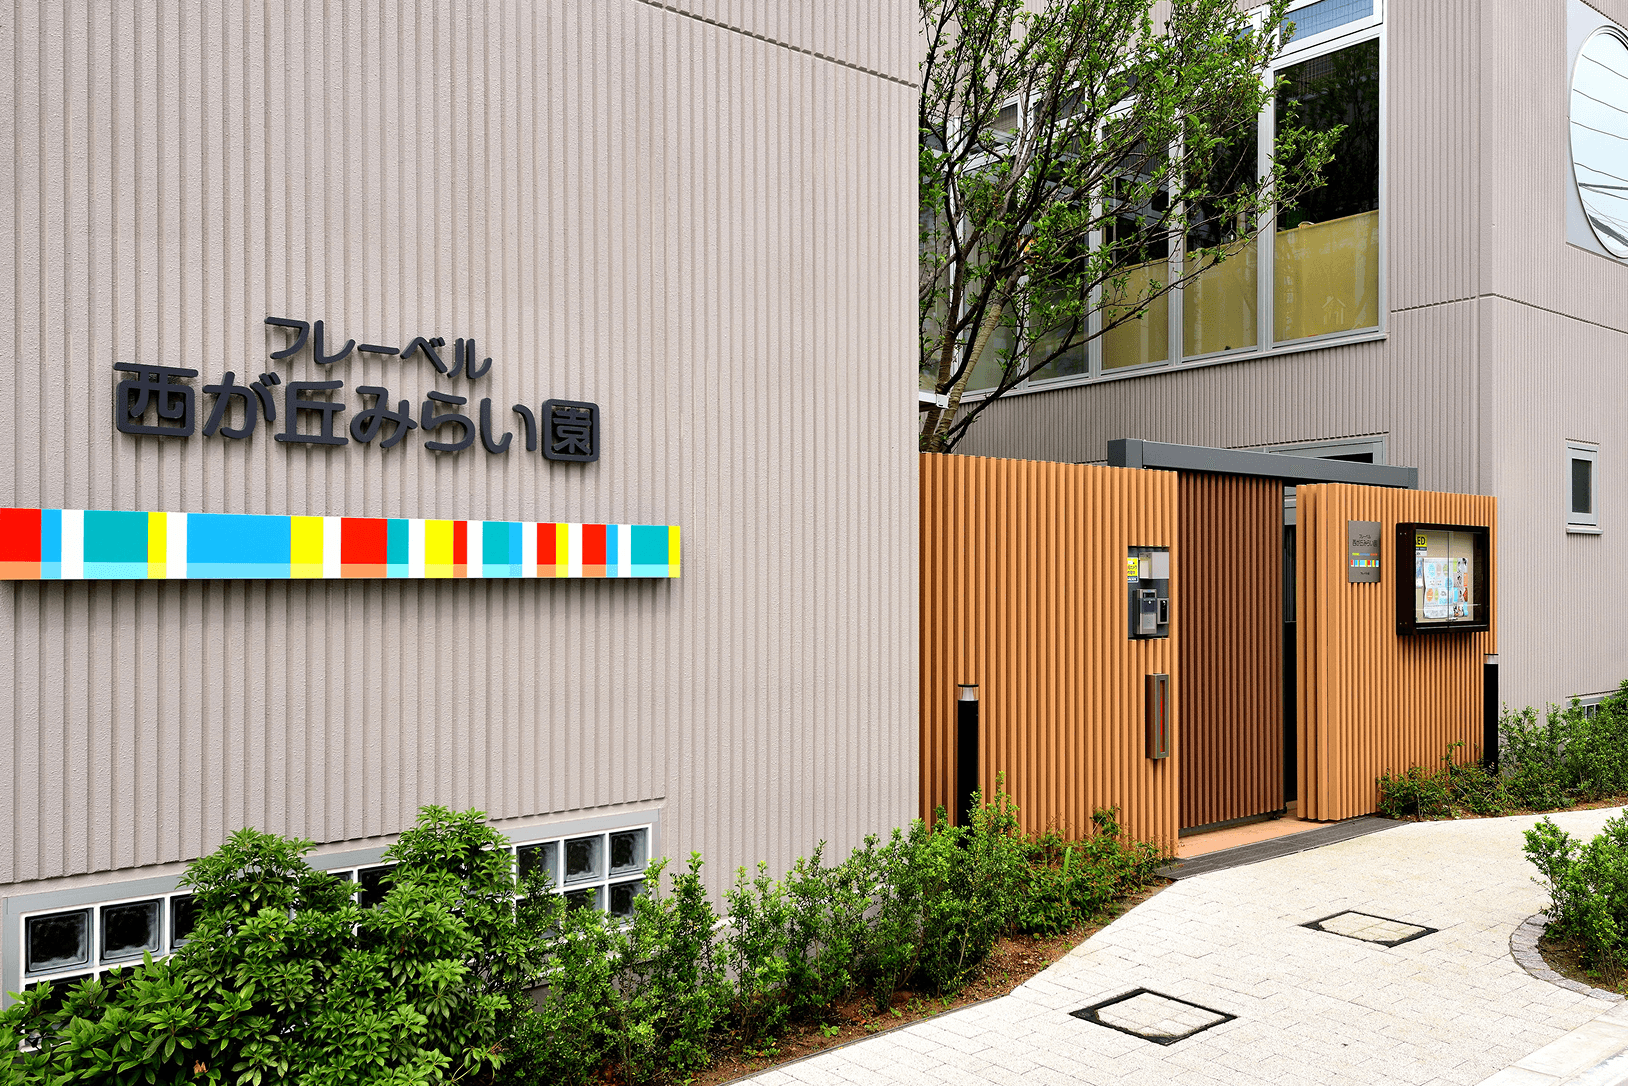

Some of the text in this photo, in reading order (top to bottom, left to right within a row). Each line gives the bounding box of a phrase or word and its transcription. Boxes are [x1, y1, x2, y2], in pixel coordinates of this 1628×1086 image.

[264, 316, 492, 380] フレーベル
[112, 361, 600, 463] 西が丘みらい園
